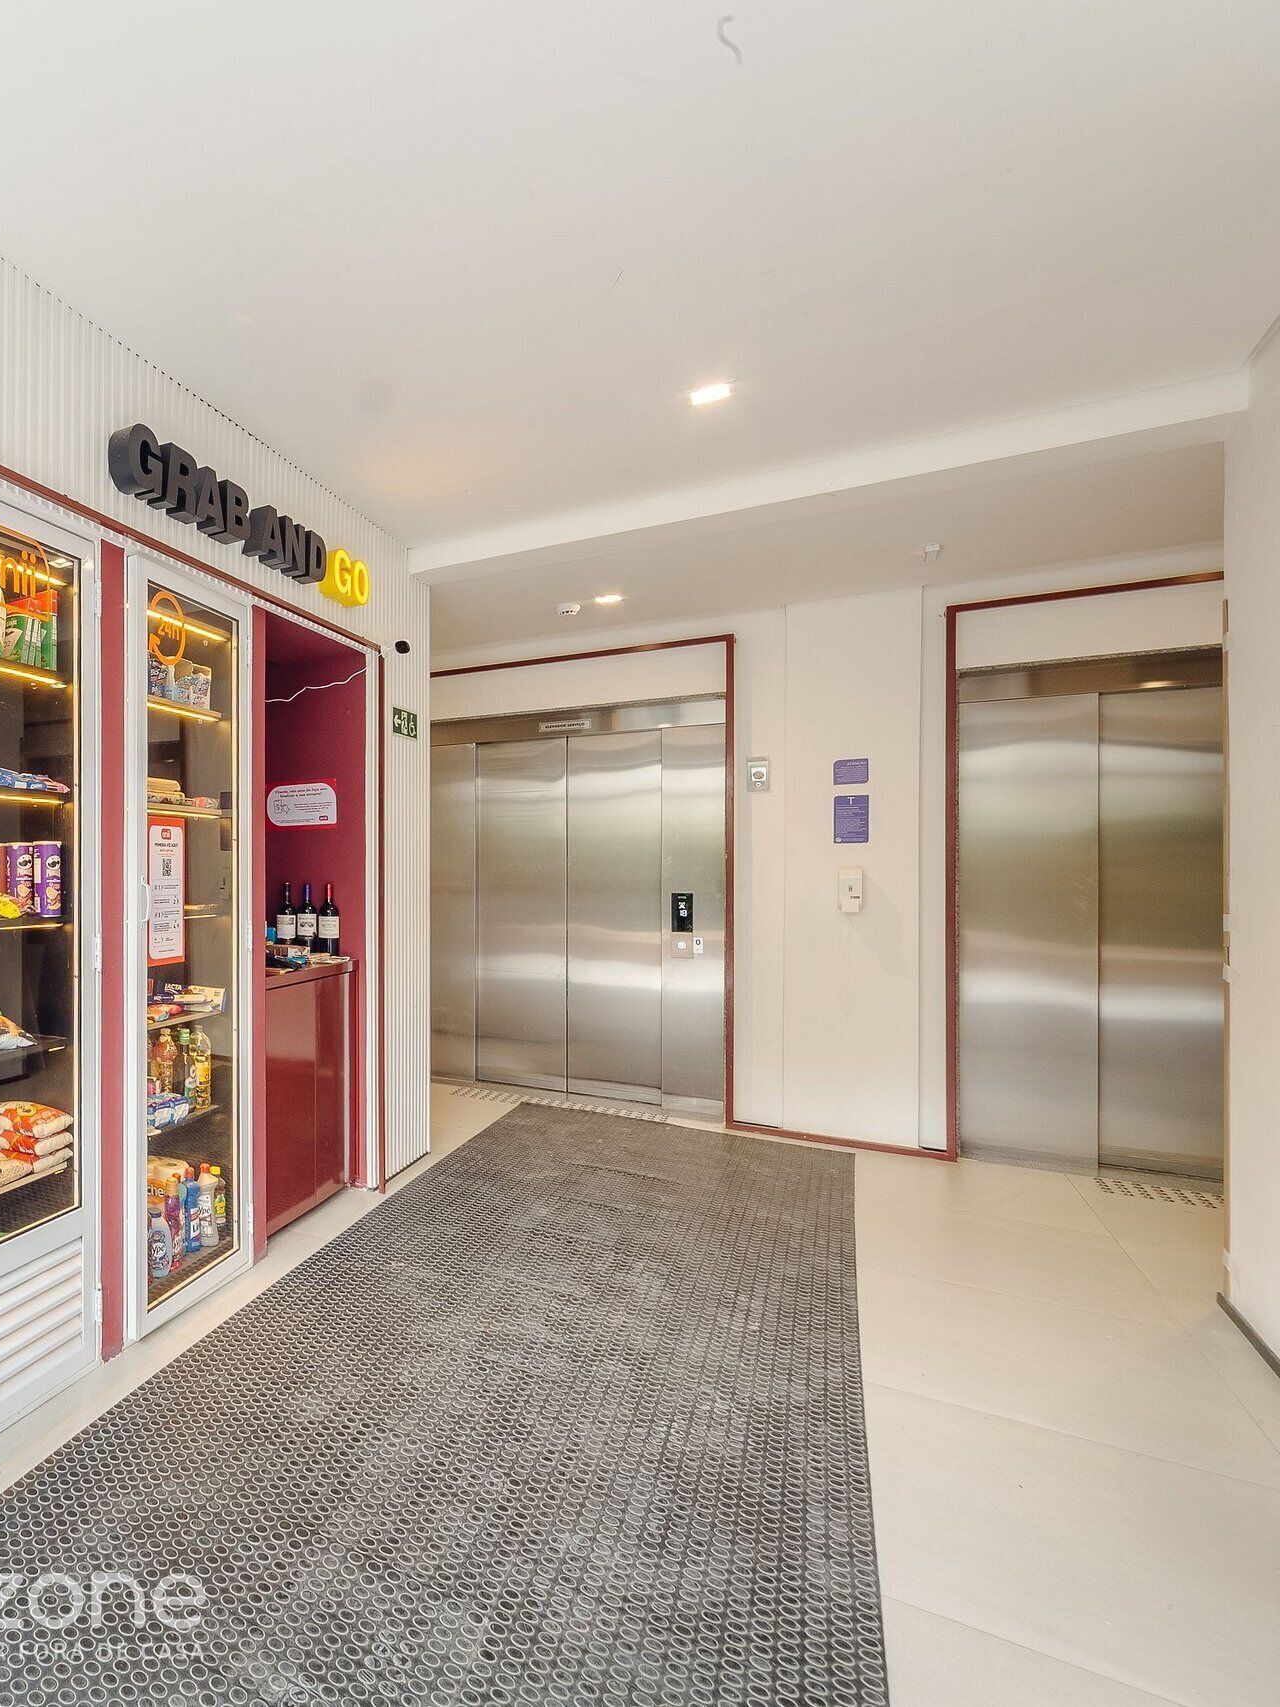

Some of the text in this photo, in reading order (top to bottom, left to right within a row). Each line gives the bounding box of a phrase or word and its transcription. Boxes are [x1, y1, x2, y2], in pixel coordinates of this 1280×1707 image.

[108, 422, 327, 585] GRAB AND
[320, 548, 371, 607] GO
[157, 617, 180, 641] 24h
[164, 982, 183, 992] LACTA
